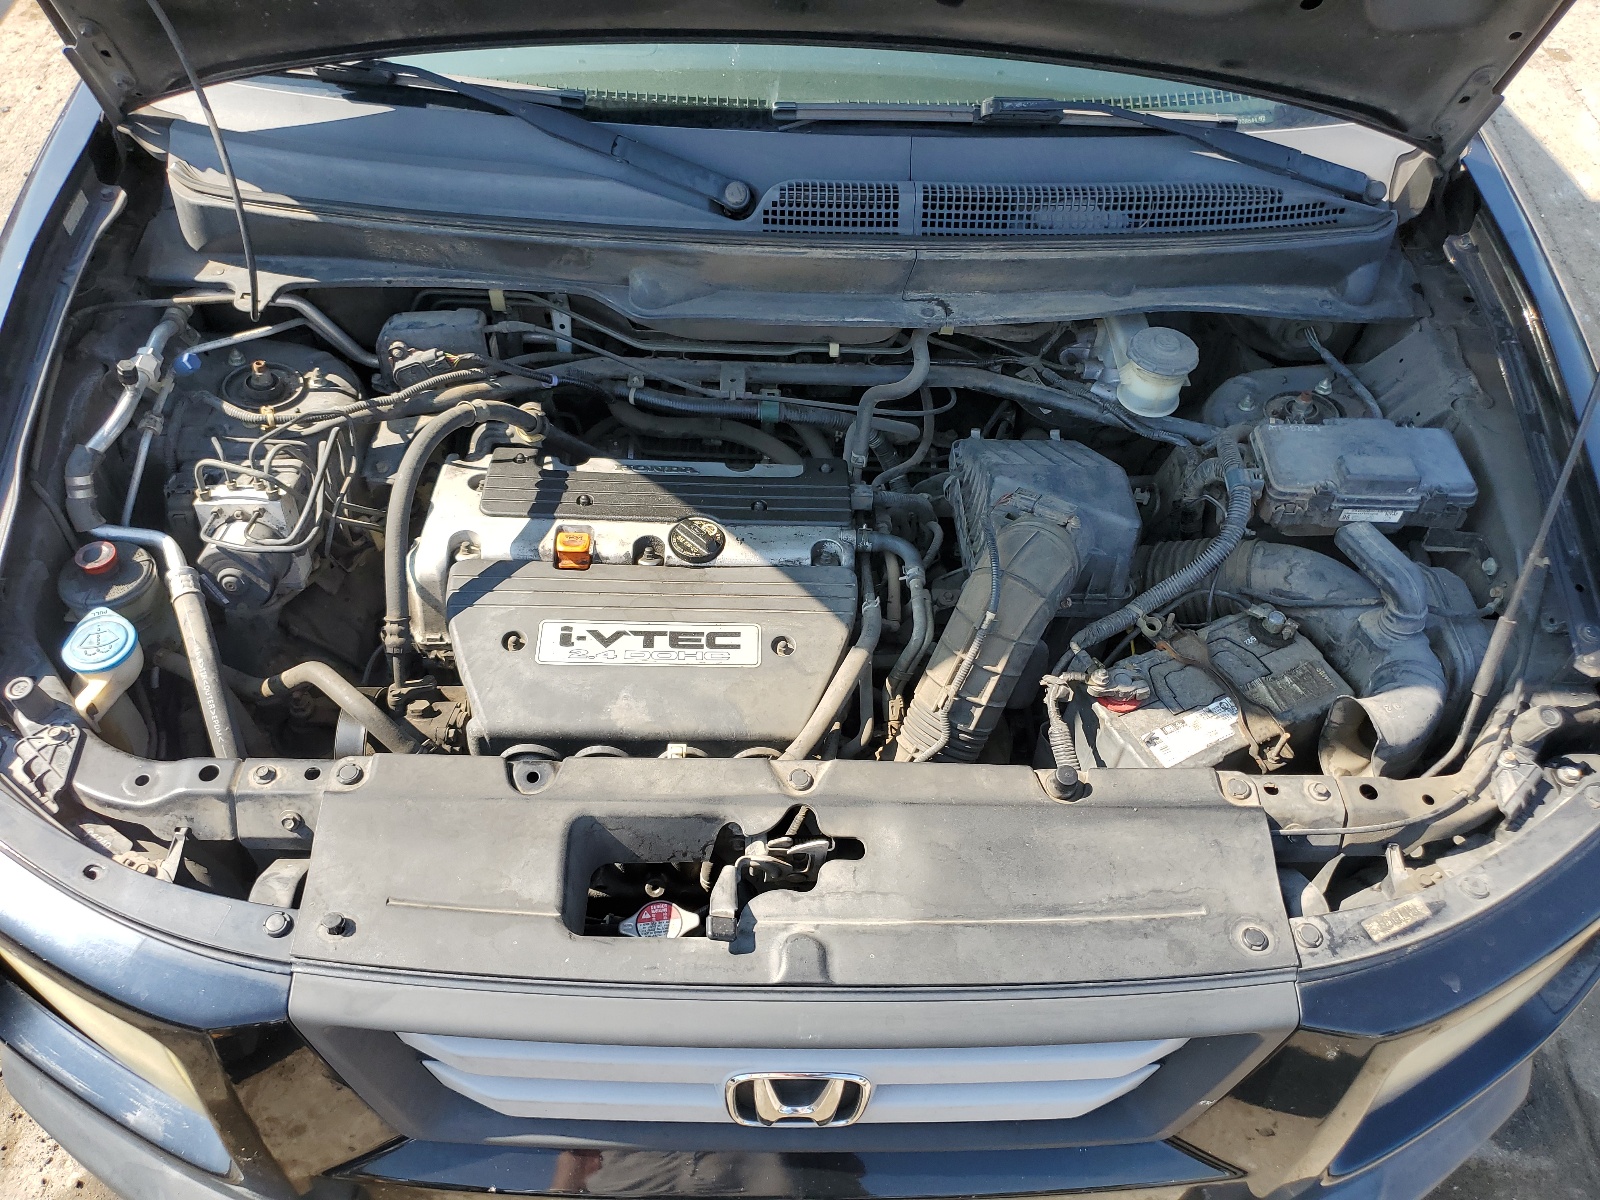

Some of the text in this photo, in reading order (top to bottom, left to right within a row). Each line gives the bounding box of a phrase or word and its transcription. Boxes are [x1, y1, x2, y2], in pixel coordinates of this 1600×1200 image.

[90, 609, 108, 617] PULL
[559, 625, 742, 649] i-VTEC
[567, 648, 731, 661] 2.4 DOHC
